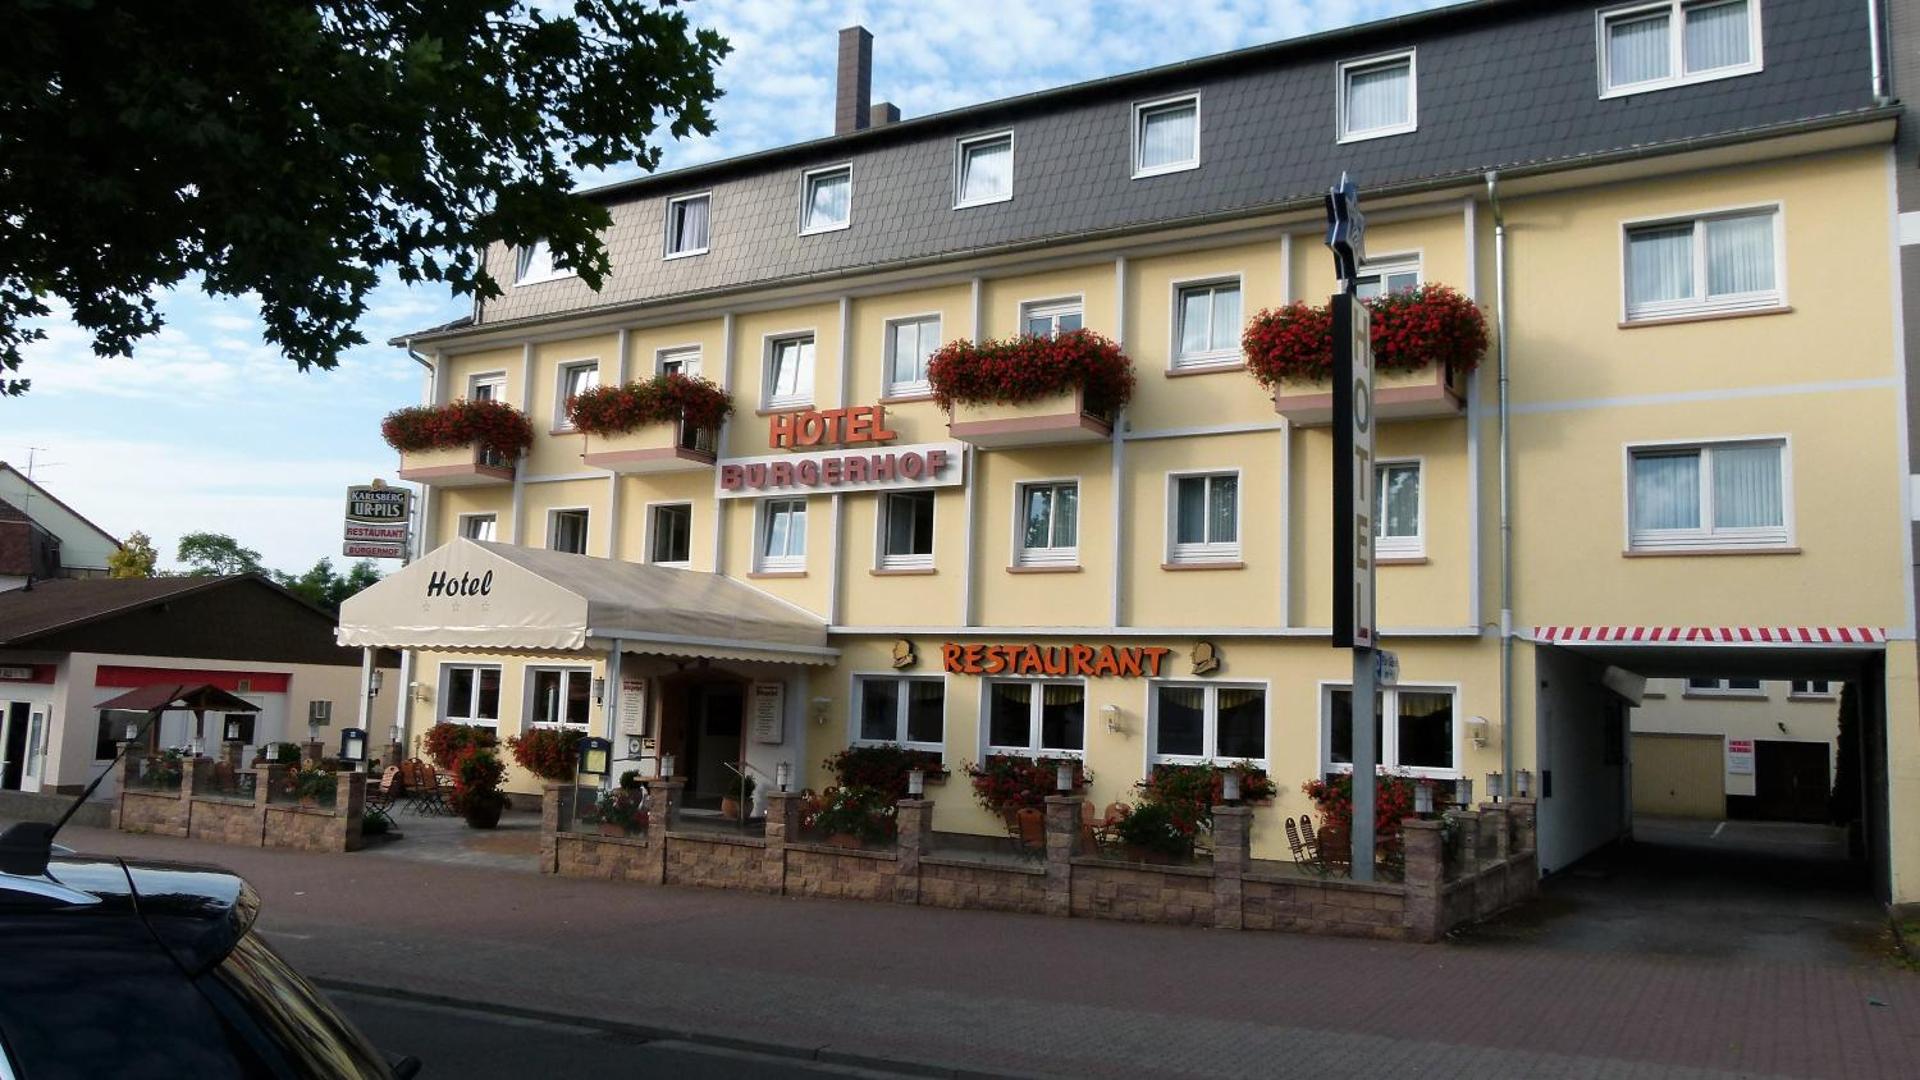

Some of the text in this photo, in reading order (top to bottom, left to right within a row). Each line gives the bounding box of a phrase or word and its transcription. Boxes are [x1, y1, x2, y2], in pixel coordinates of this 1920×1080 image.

[769, 405, 897, 450] HOTEL
[721, 450, 947, 491] BURGERHOF
[1354, 307, 1369, 639] HOTEL
[351, 490, 404, 502] KARLSBERG
[354, 502, 400, 517] UR-PILS
[347, 528, 404, 538] RESTAURANT
[427, 569, 493, 597] Hotel
[941, 642, 1171, 677] RESTAURANT
